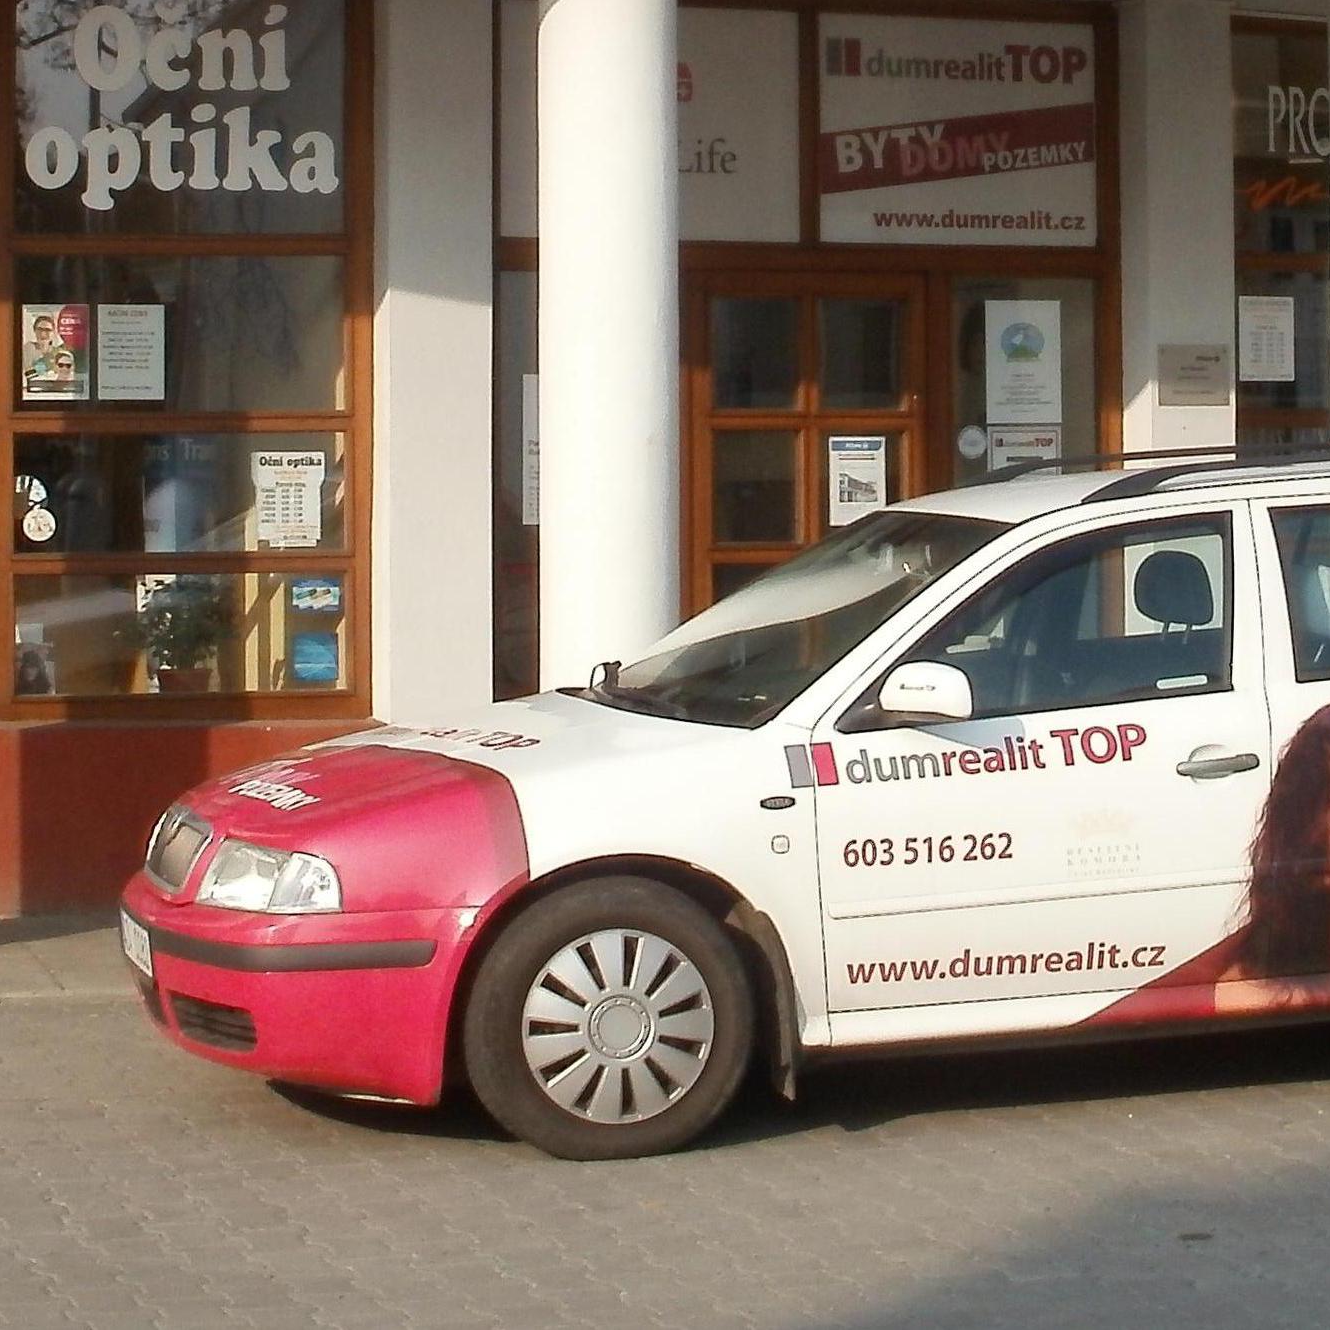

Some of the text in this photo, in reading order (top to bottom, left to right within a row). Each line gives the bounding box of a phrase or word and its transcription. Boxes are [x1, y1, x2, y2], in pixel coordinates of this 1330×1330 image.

[866, 44, 1088, 85] dumrealitTOP
[24, 102, 340, 211] optika
[835, 124, 946, 172] BYTY
[983, 141, 1087, 172] POZEMKY
[873, 209, 1087, 230] www.dumrealit.cz
[843, 831, 1014, 868] 603 516 262
[847, 941, 1167, 984] www.dumrealit.cz
